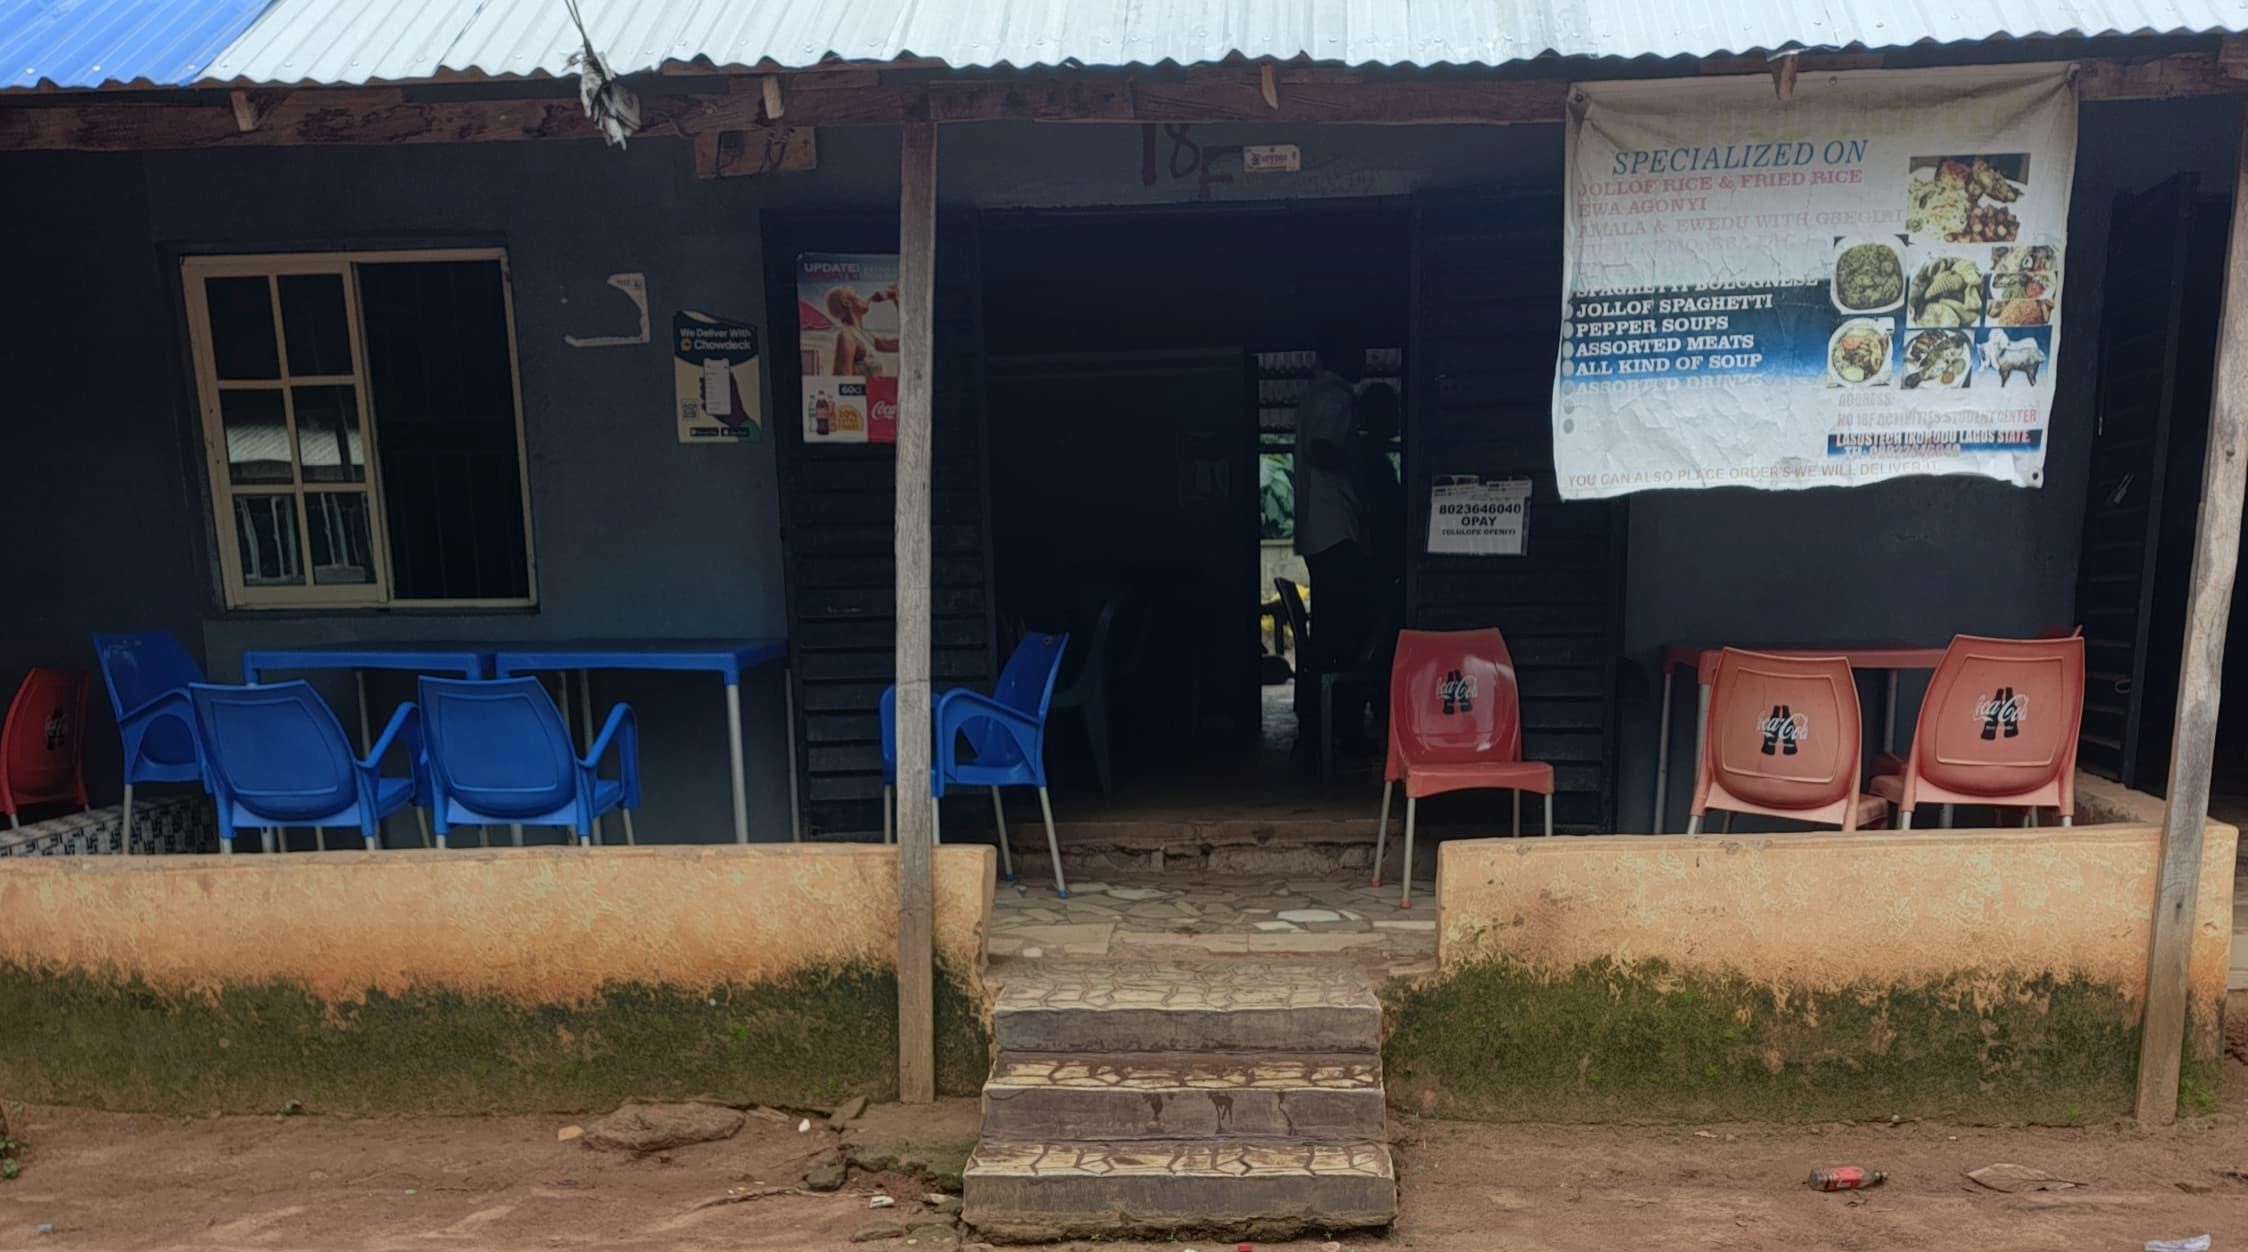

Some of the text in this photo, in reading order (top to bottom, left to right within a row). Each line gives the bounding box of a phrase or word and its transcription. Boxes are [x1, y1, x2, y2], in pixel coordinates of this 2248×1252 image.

[1612, 139, 1870, 176] SPECIALIZED ON
[1578, 169, 1863, 197] JOLLOF RICE & FRIED RICE
[1578, 197, 1708, 217] EWA AGONYI
[1675, 215, 1749, 233] EWEDU
[1756, 211, 1808, 228] WITH
[1576, 293, 1773, 318] JOLLOF SPAGHETTI
[680, 327, 751, 338] We Deliver With
[1575, 315, 1729, 338] PEPPER SOUPS
[694, 339, 752, 350] Chowdeck
[1575, 334, 1754, 358] ASSORTED MEATS
[1575, 353, 1763, 377] ALL KIND OF SOUP
[1567, 473, 1595, 488] YOU
[1600, 471, 1630, 486] CAN
[1633, 469, 1673, 483] ALSO
[1821, 463, 1857, 477] WILL
[1461, 516, 1497, 527] OPAY
